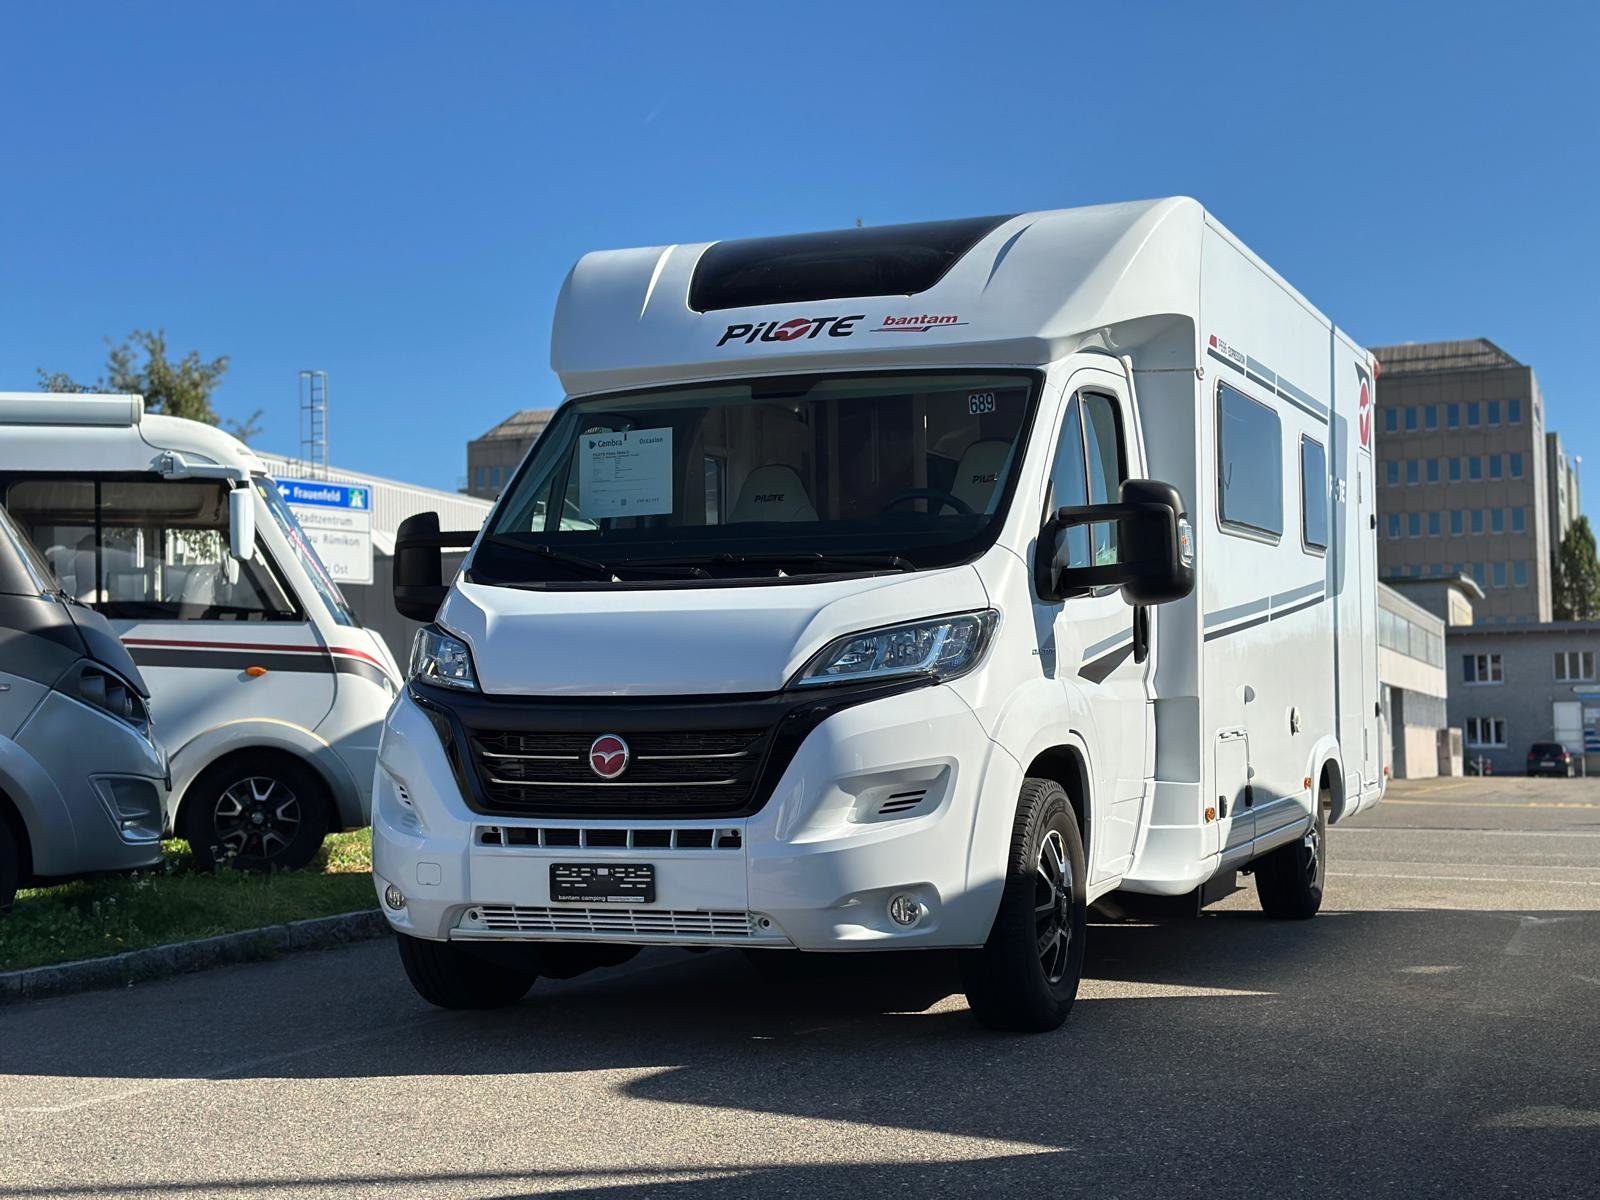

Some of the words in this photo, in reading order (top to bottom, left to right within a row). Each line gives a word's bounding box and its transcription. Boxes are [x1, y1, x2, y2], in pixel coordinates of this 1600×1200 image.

[882, 314, 959, 327] bantam
[970, 393, 994, 413] 689
[598, 439, 622, 448] Cembra
[640, 437, 663, 445] Occasion
[293, 486, 341, 502] Frauenfeld
[295, 511, 353, 526] Stadtzentrum
[323, 533, 361, 547] Rümikon
[333, 564, 349, 575] Ost
